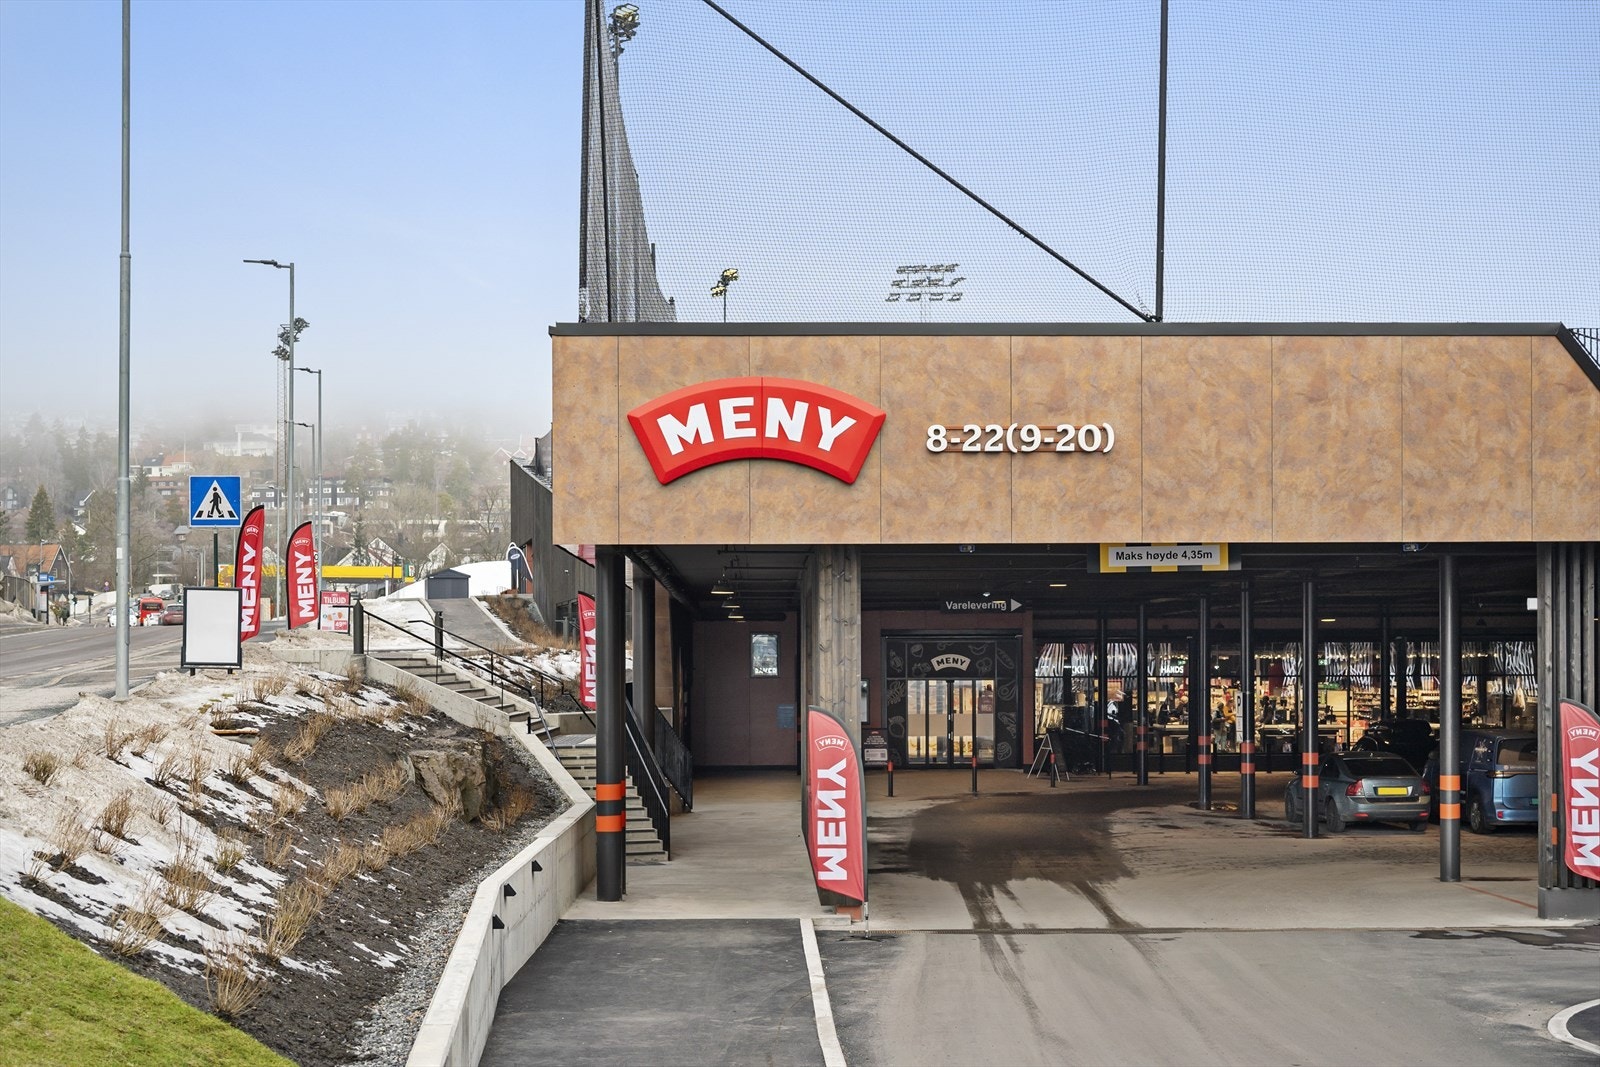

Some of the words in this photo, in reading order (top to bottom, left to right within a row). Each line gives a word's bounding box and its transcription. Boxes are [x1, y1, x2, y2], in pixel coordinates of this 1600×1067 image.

[656, 397, 857, 456] MENY
[926, 422, 1115, 453] 8-22(9-20)
[1115, 552, 1143, 561] Maks
[1146, 551, 1178, 562] høyde
[1181, 550, 1213, 560] 4,35m
[241, 542, 256, 632] MENY
[294, 551, 315, 618] MENY
[946, 601, 1007, 611] Varelevering
[936, 657, 966, 667] MENY
